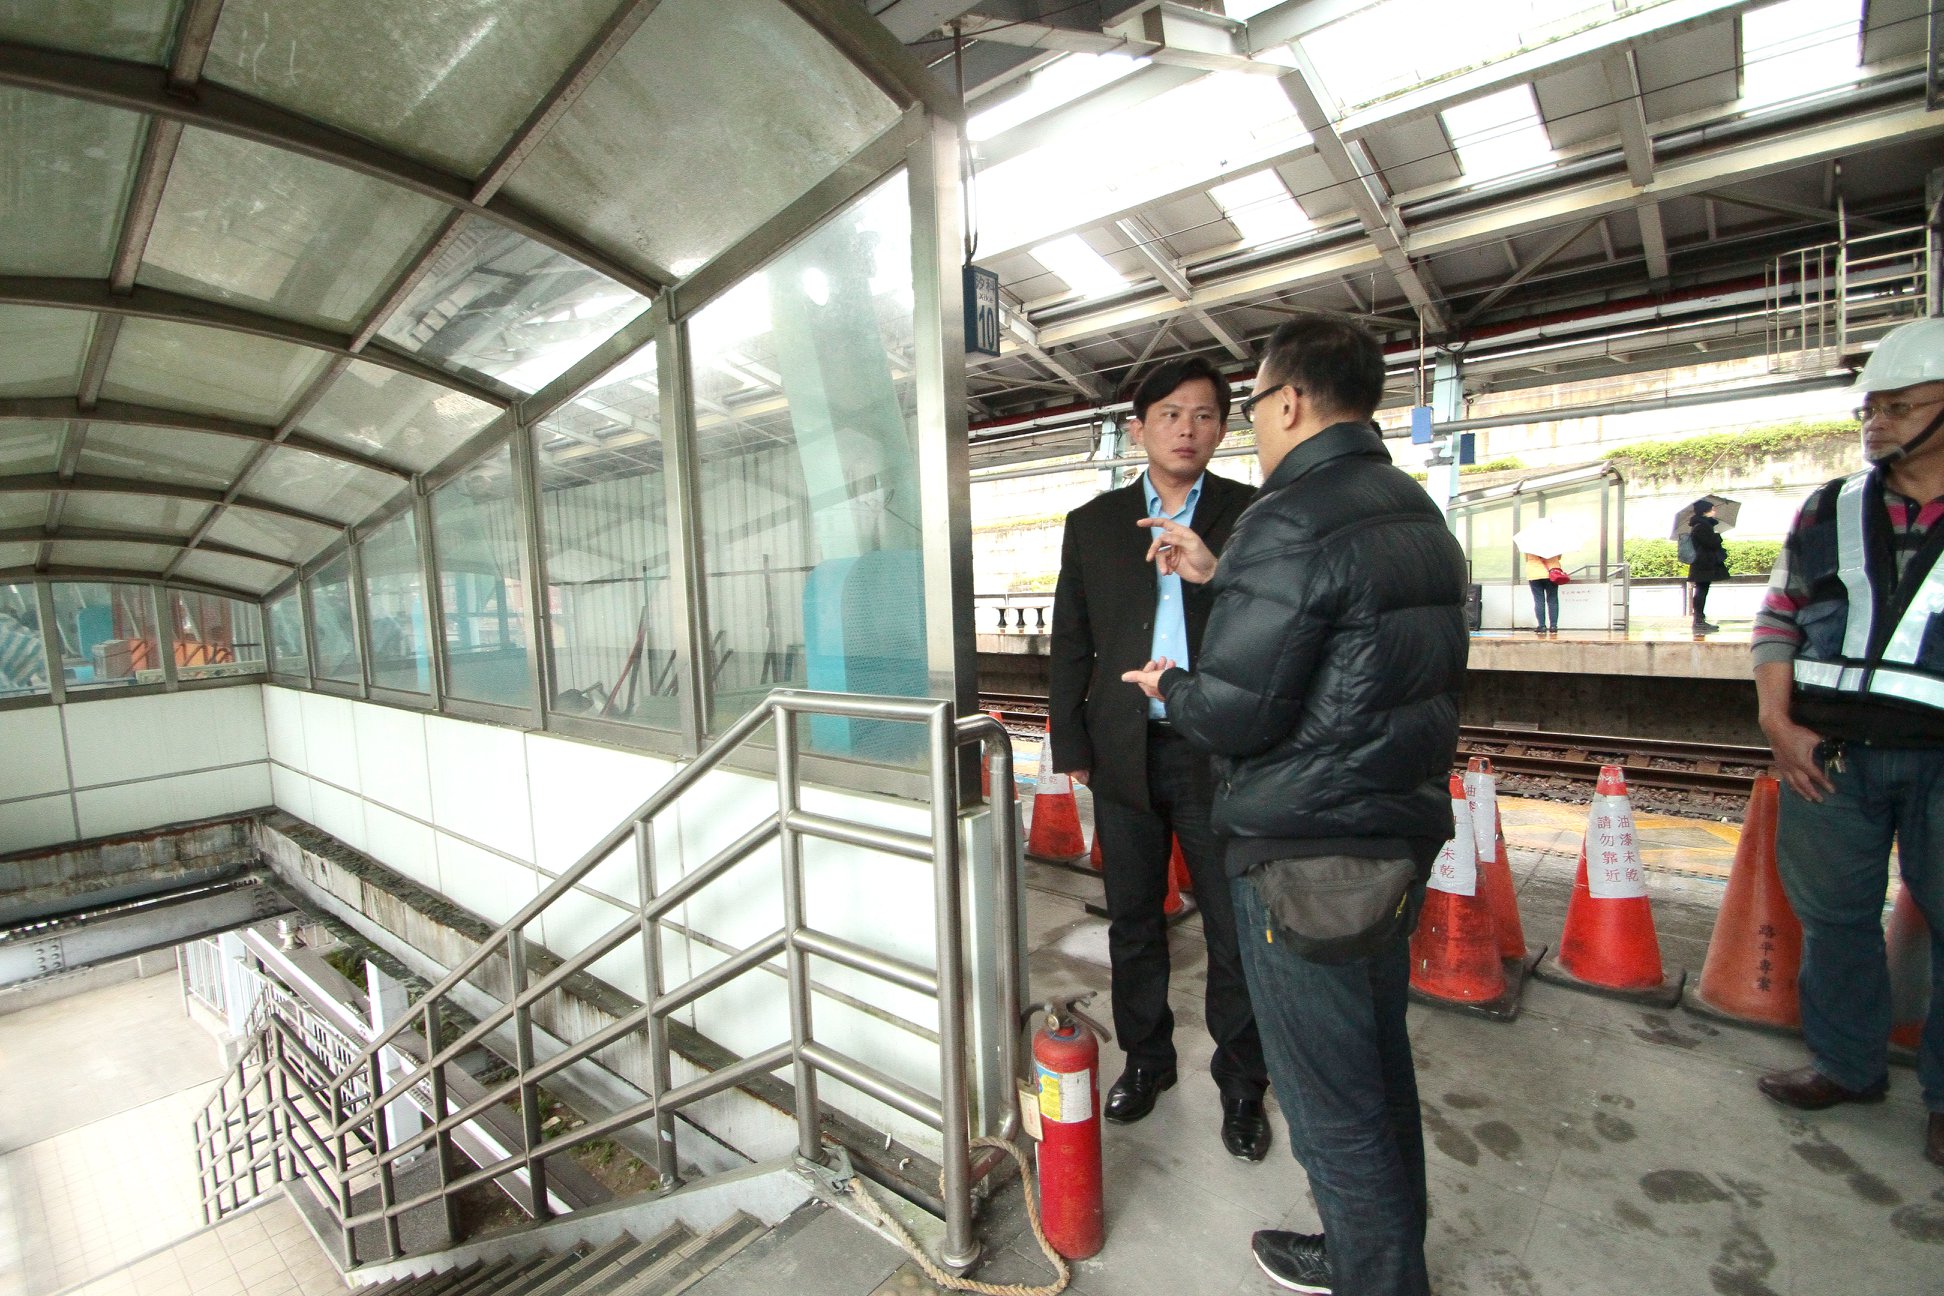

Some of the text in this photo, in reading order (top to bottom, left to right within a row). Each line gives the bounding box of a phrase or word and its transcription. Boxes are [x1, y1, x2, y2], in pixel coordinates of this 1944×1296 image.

[975, 274, 995, 295] 汐科
[979, 293, 994, 304] Xike
[979, 305, 994, 351] 10
[1597, 816, 1621, 882] 請勿靠近
[1618, 815, 1639, 882] 油漆未乾
